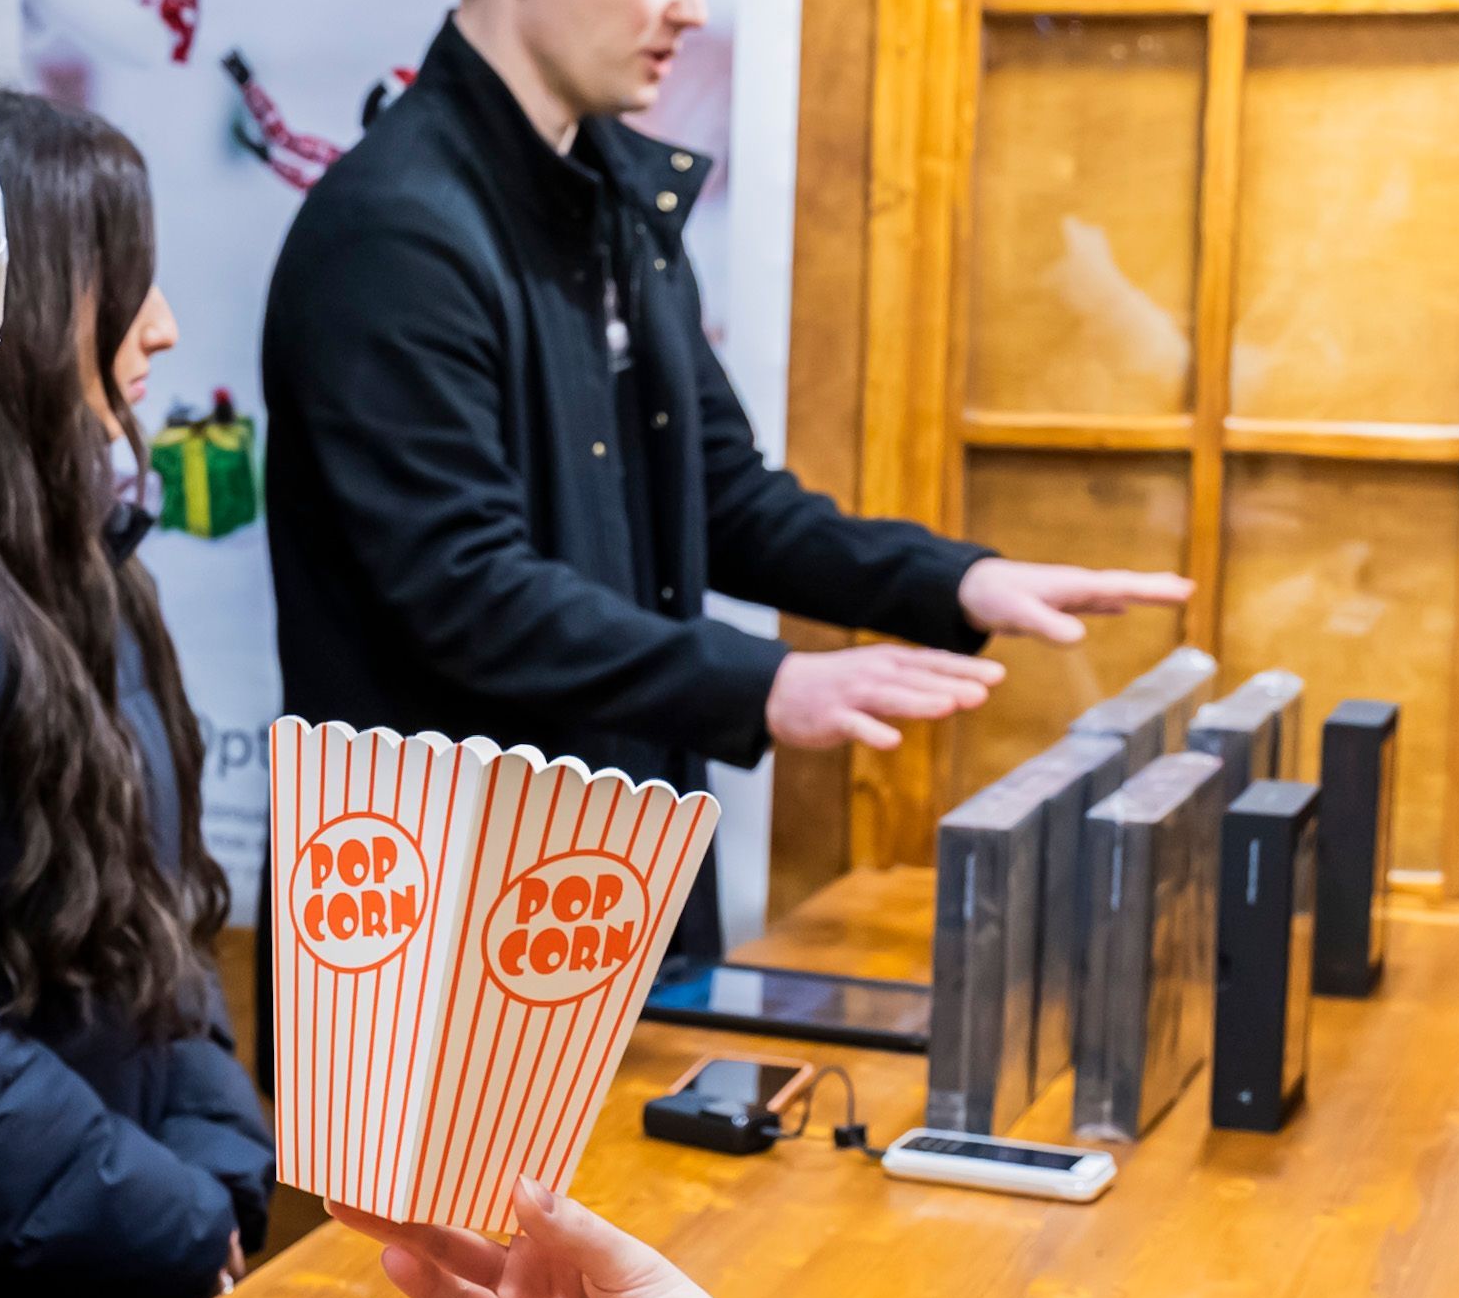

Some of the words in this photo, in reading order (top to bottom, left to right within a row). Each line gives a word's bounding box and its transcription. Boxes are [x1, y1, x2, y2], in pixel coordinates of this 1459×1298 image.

[310, 836, 398, 889] POP
[303, 885, 418, 942] CORN
[515, 873, 624, 926] POP
[497, 920, 635, 978] CORN
